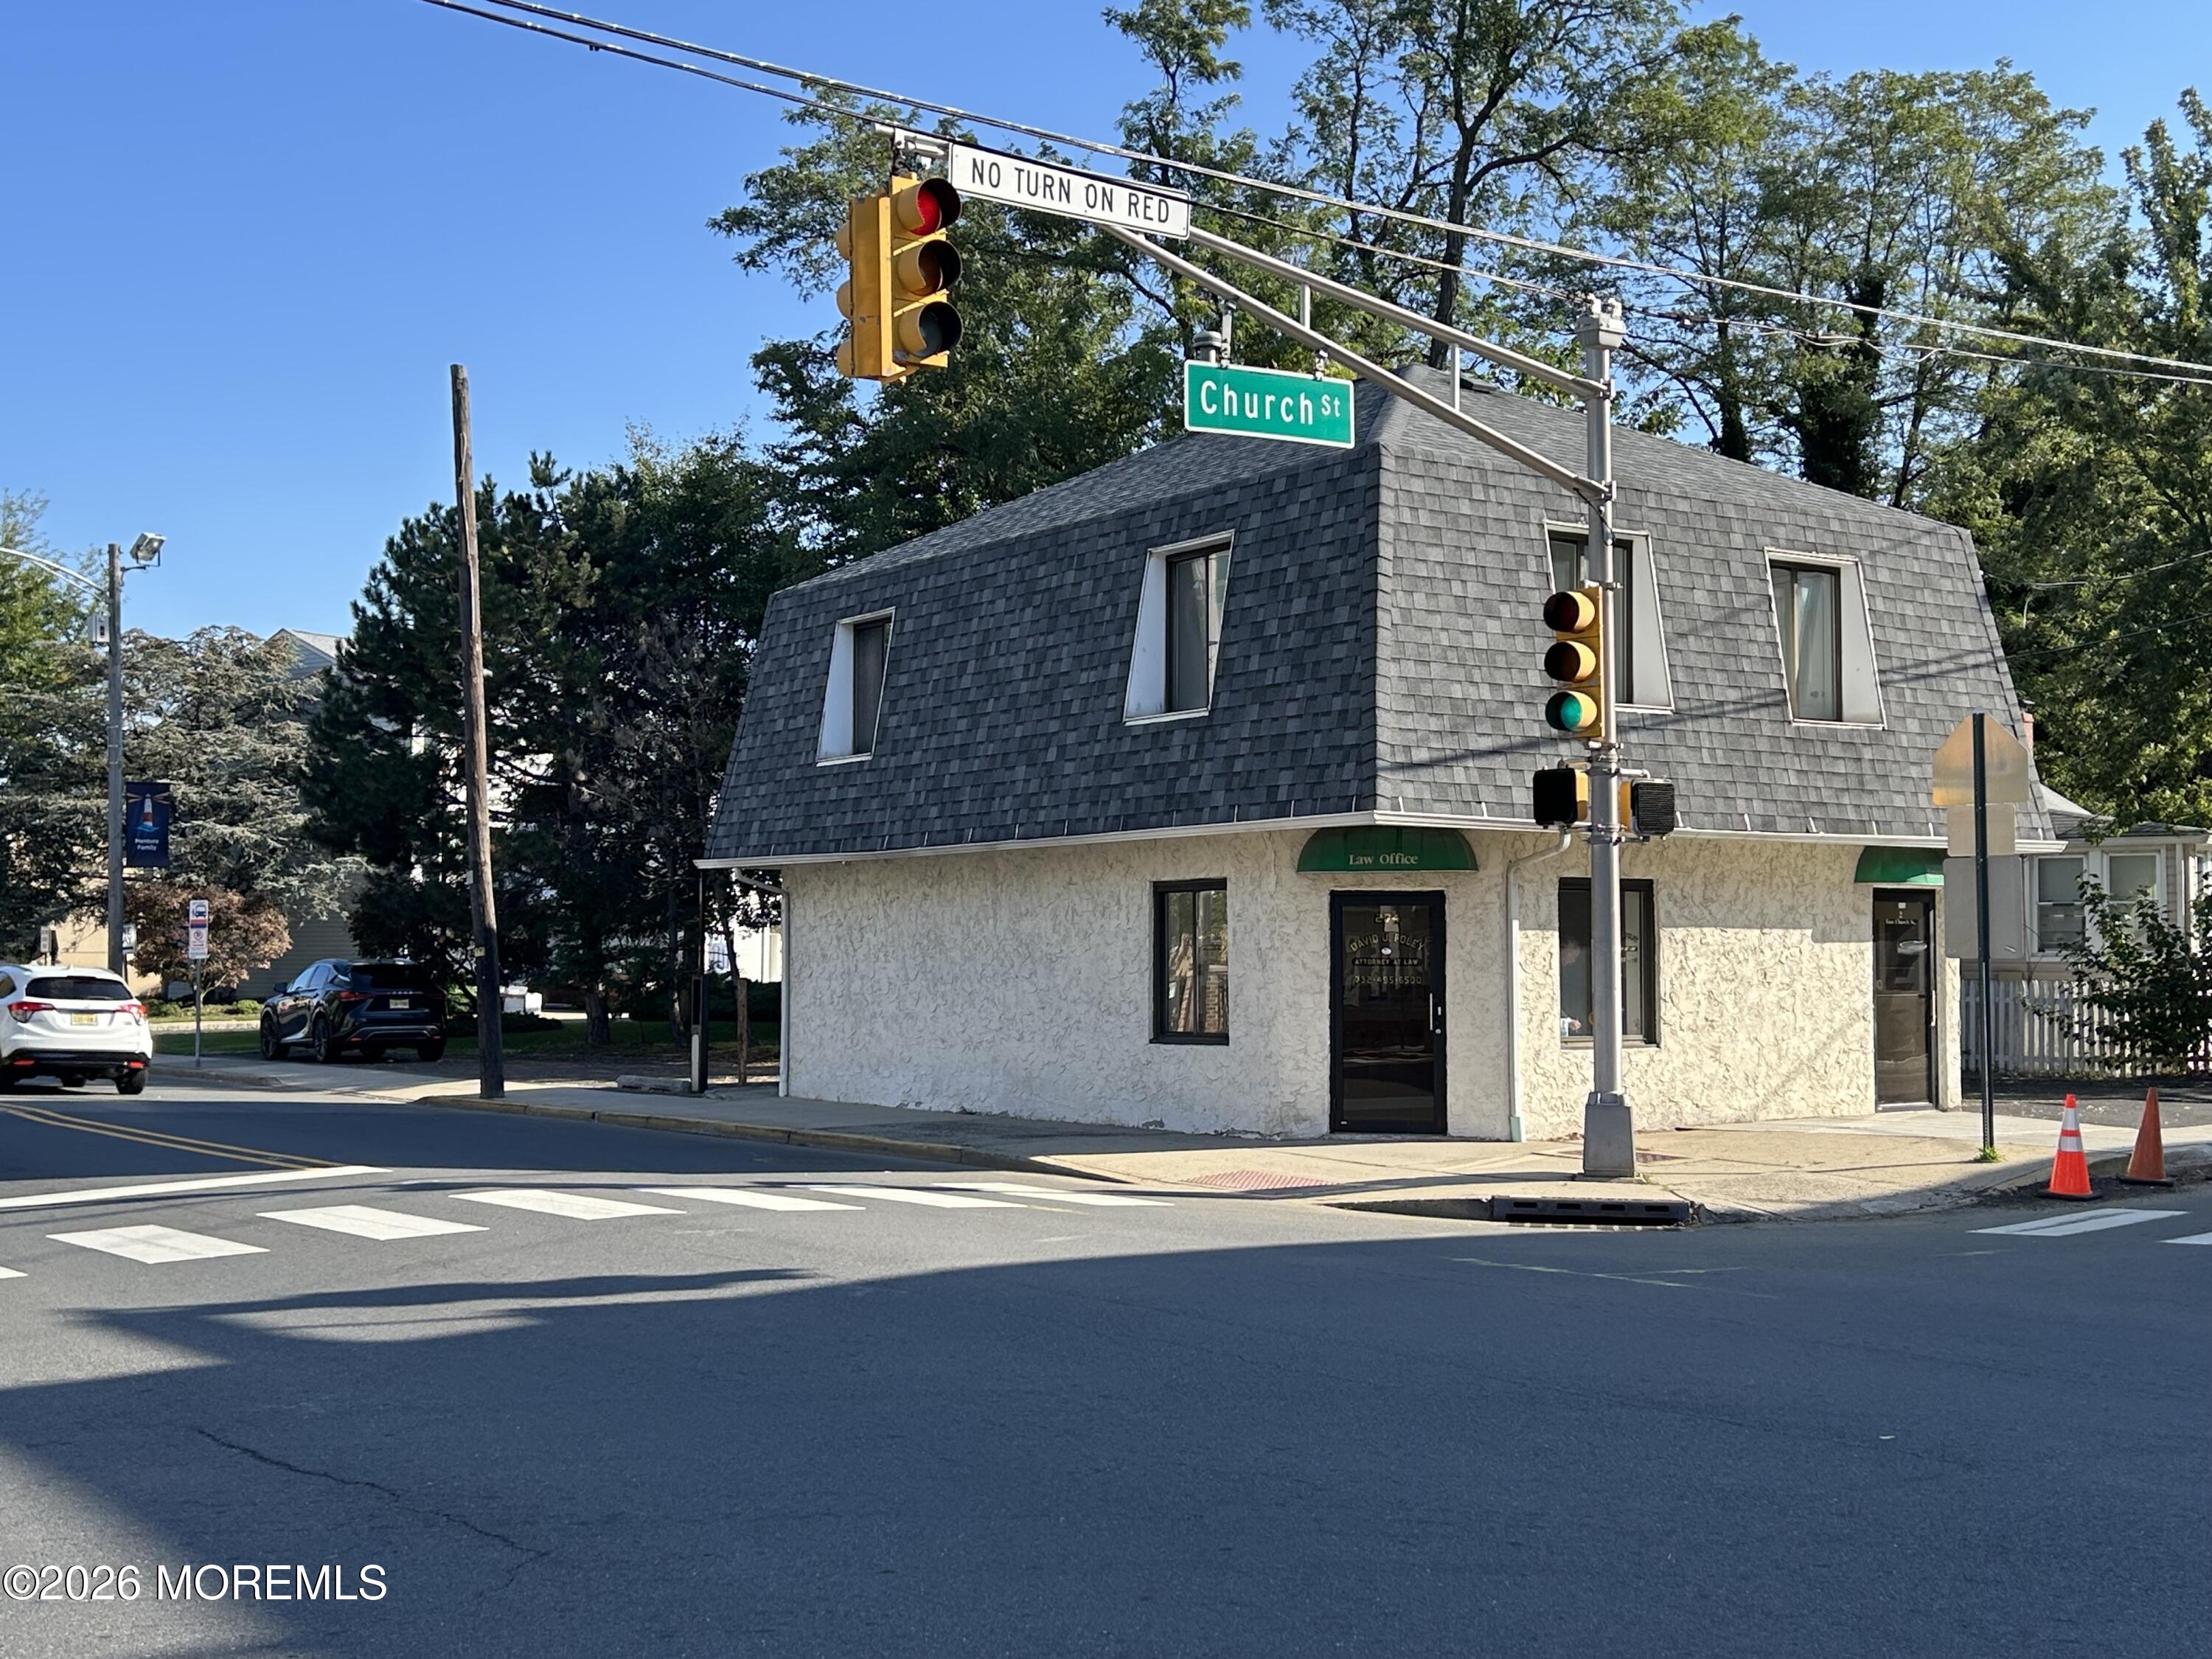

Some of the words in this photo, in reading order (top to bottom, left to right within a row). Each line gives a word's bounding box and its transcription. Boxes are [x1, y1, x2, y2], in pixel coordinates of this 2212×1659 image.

[972, 158, 1001, 189] NO
[1015, 167, 1071, 204] TURN
[1085, 184, 1113, 212] ON
[1127, 192, 1170, 224] RED
[1200, 380, 1314, 425] Church
[1321, 393, 1341, 418] St
[1349, 855, 1374, 865] Law
[1379, 852, 1419, 865] Office
[123, 926, 131, 935] NE
[1350, 934, 1379, 951] DAVID
[1394, 933, 1425, 951] FOLEY
